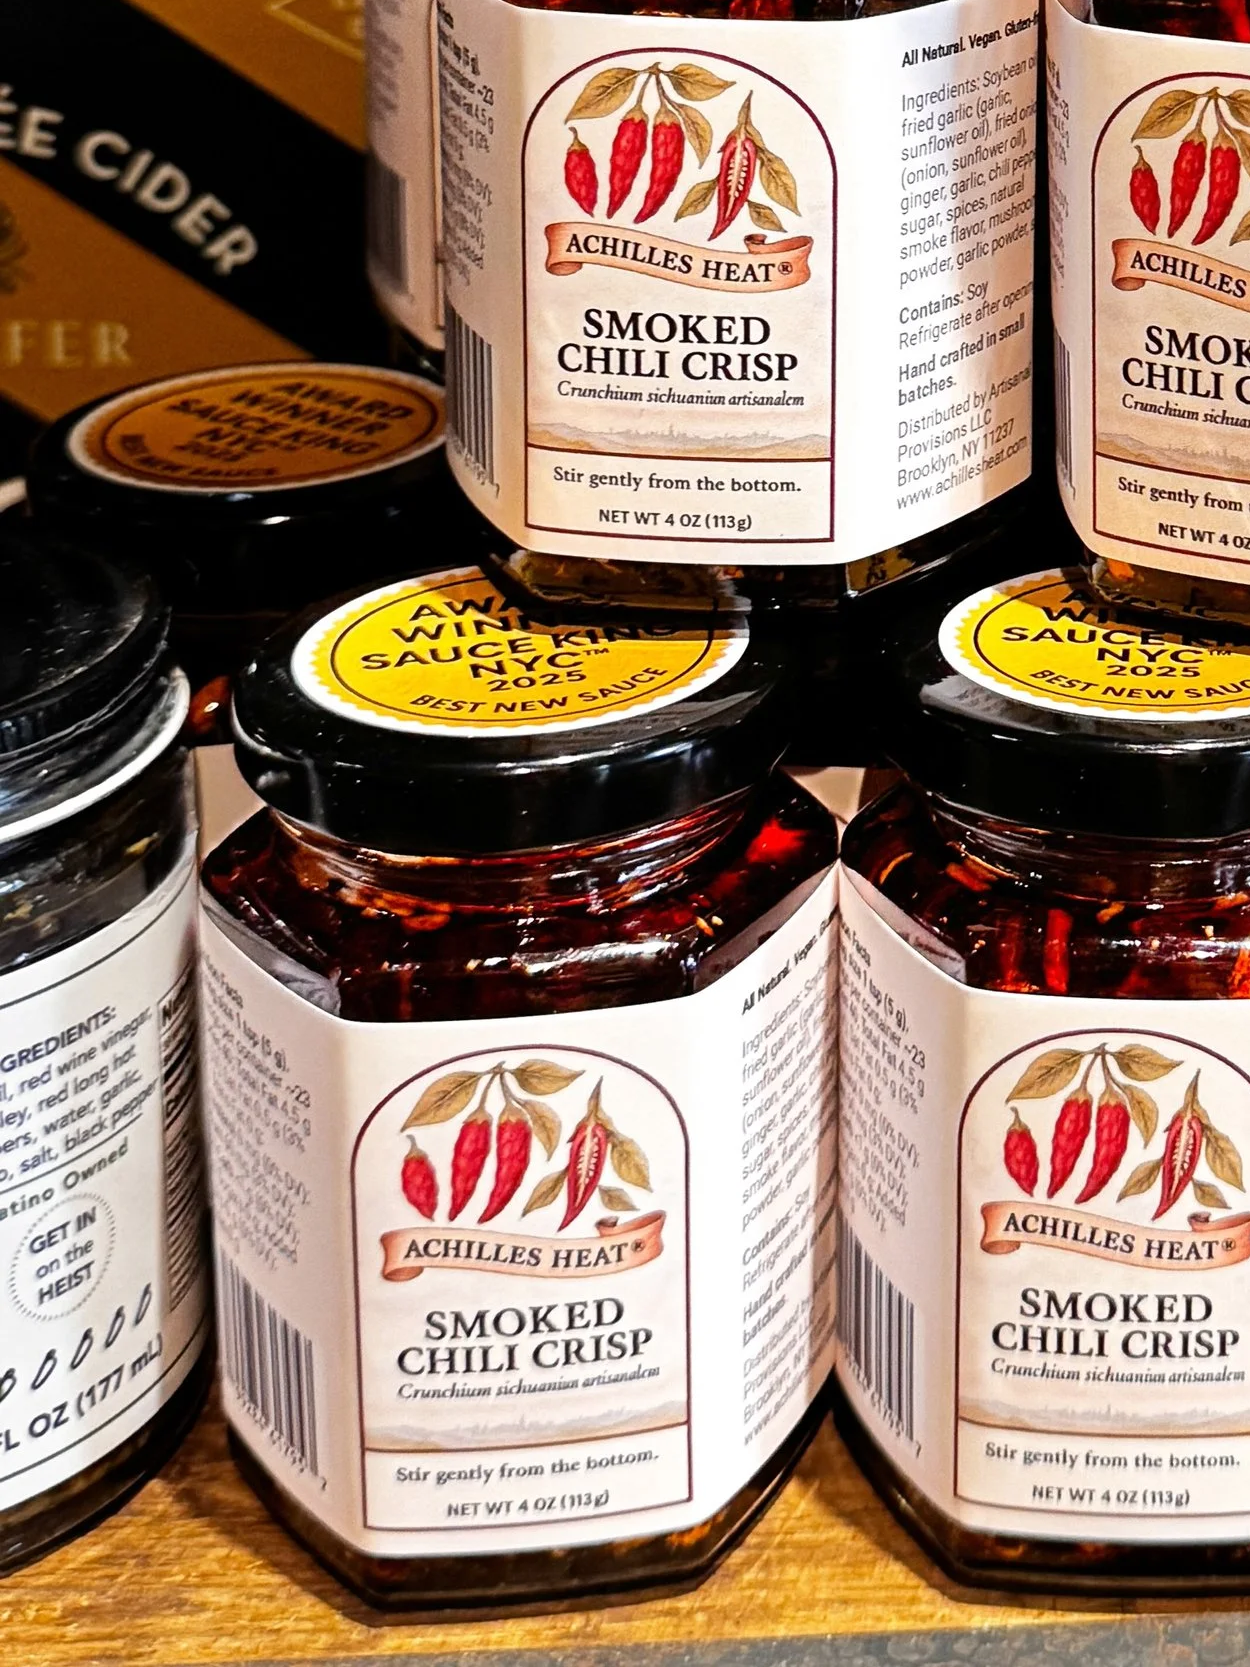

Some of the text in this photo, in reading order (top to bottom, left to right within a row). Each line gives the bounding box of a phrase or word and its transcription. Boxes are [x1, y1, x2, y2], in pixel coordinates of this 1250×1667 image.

[75, 130, 258, 276] CIDER
[566, 234, 693, 274] ACHILLES
[1131, 251, 1247, 298] ACHILLES
[583, 308, 770, 345] SMOKED
[558, 343, 798, 381] CHILI CRISP
[1123, 358, 1224, 400] CHILI
[554, 466, 801, 492] Stir gently from the bottom.
[1119, 477, 1145, 494] Stir
[1150, 487, 1199, 508] gently
[1204, 492, 1242, 512] from
[599, 510, 751, 531] NET WT 4 OZ (113g)
[1158, 523, 1187, 538] NET
[1190, 529, 1215, 542] WT
[1219, 535, 1228, 546] 4
[361, 637, 532, 669] SAUCE
[1002, 627, 1166, 646] SAUCE
[410, 667, 667, 713] BEST NEW SAUCE
[488, 670, 586, 692] 2025
[1031, 670, 1099, 692] BEST
[1102, 686, 1175, 698] NEW
[1106, 665, 1200, 677] 2025
[19, 1047, 97, 1094] red wine
[63, 1137, 128, 1190] Owned
[29, 1206, 97, 1255] GET IN
[1003, 1213, 1135, 1253] ACHILLES
[36, 1238, 93, 1279] on the
[404, 1239, 542, 1267] ACHILLES
[37, 1260, 95, 1305] HEIST
[425, 1297, 624, 1340] SMOKED
[1020, 1288, 1212, 1323] SMOKED
[398, 1328, 653, 1375] CHILI CRISP
[992, 1322, 1240, 1359] CHILI CRISP
[28, 1363, 126, 1438] OZ (177
